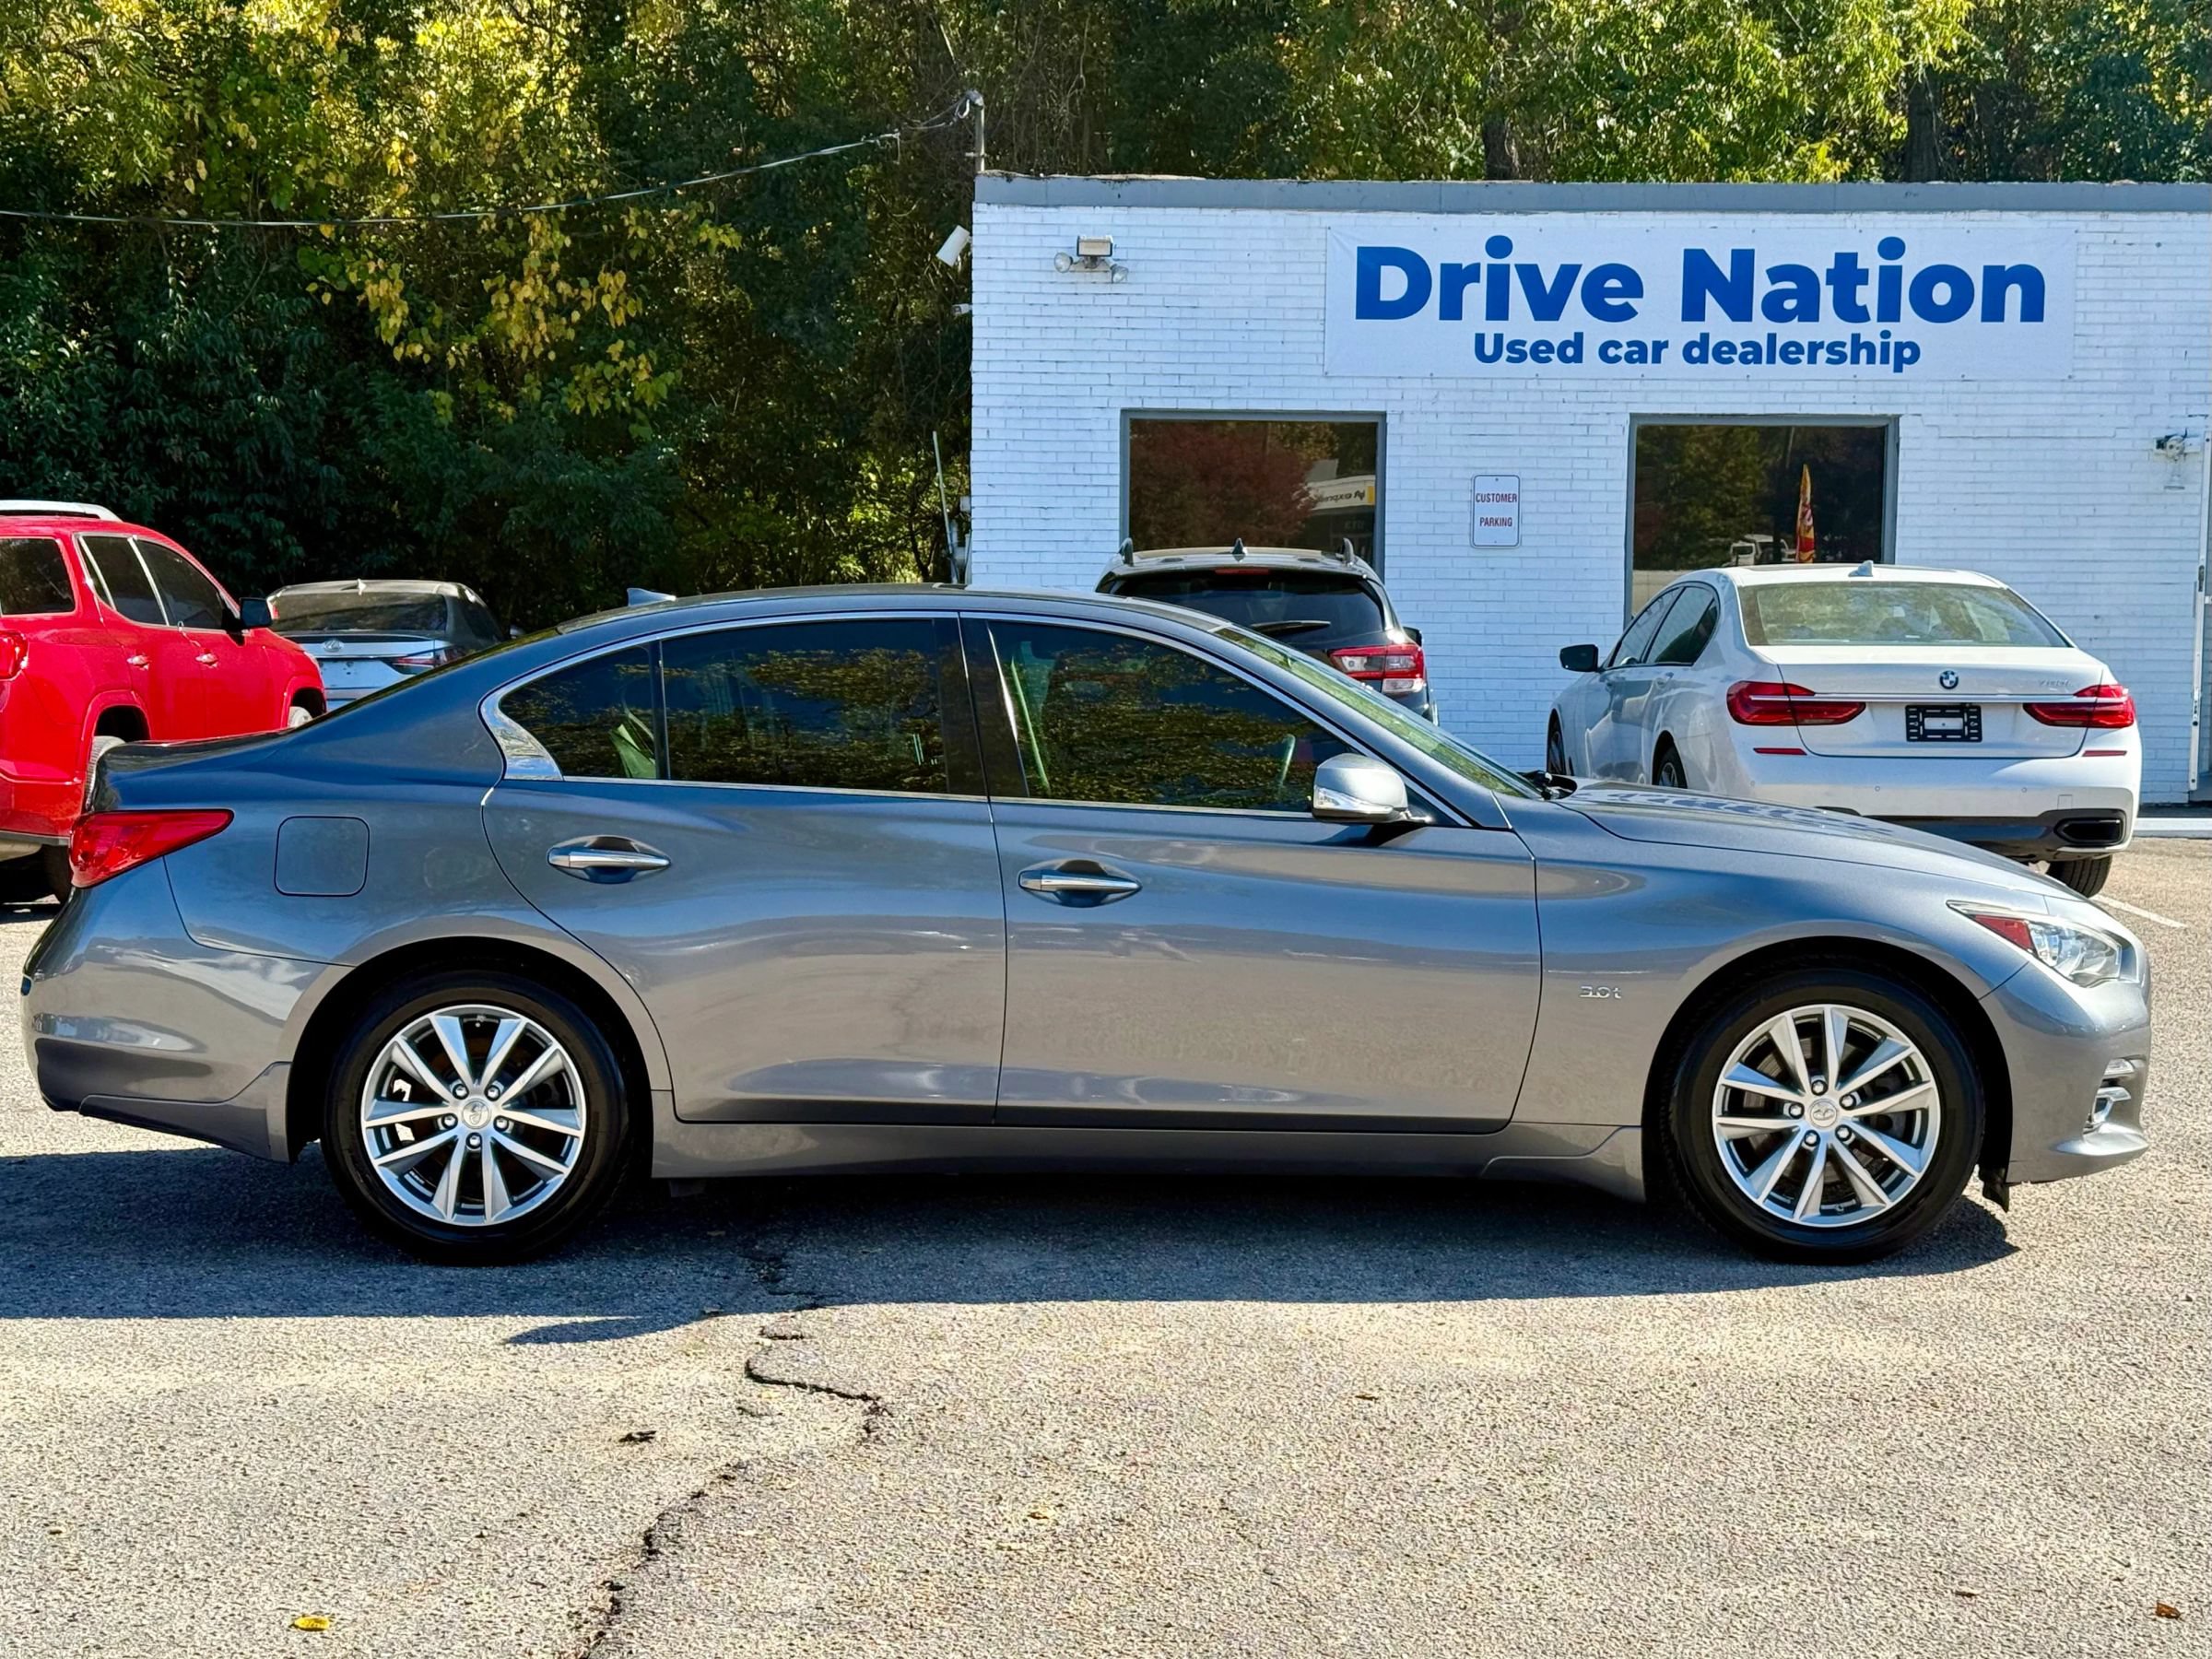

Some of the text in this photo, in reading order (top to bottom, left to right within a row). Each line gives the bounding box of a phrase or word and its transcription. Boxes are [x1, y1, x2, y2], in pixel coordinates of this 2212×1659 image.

[1355, 234, 2046, 324] Drive Nation
[1474, 329, 1921, 373] Used car dealership
[1476, 492, 1518, 503] CUSTOMER
[1479, 516, 1513, 527] PARKING
